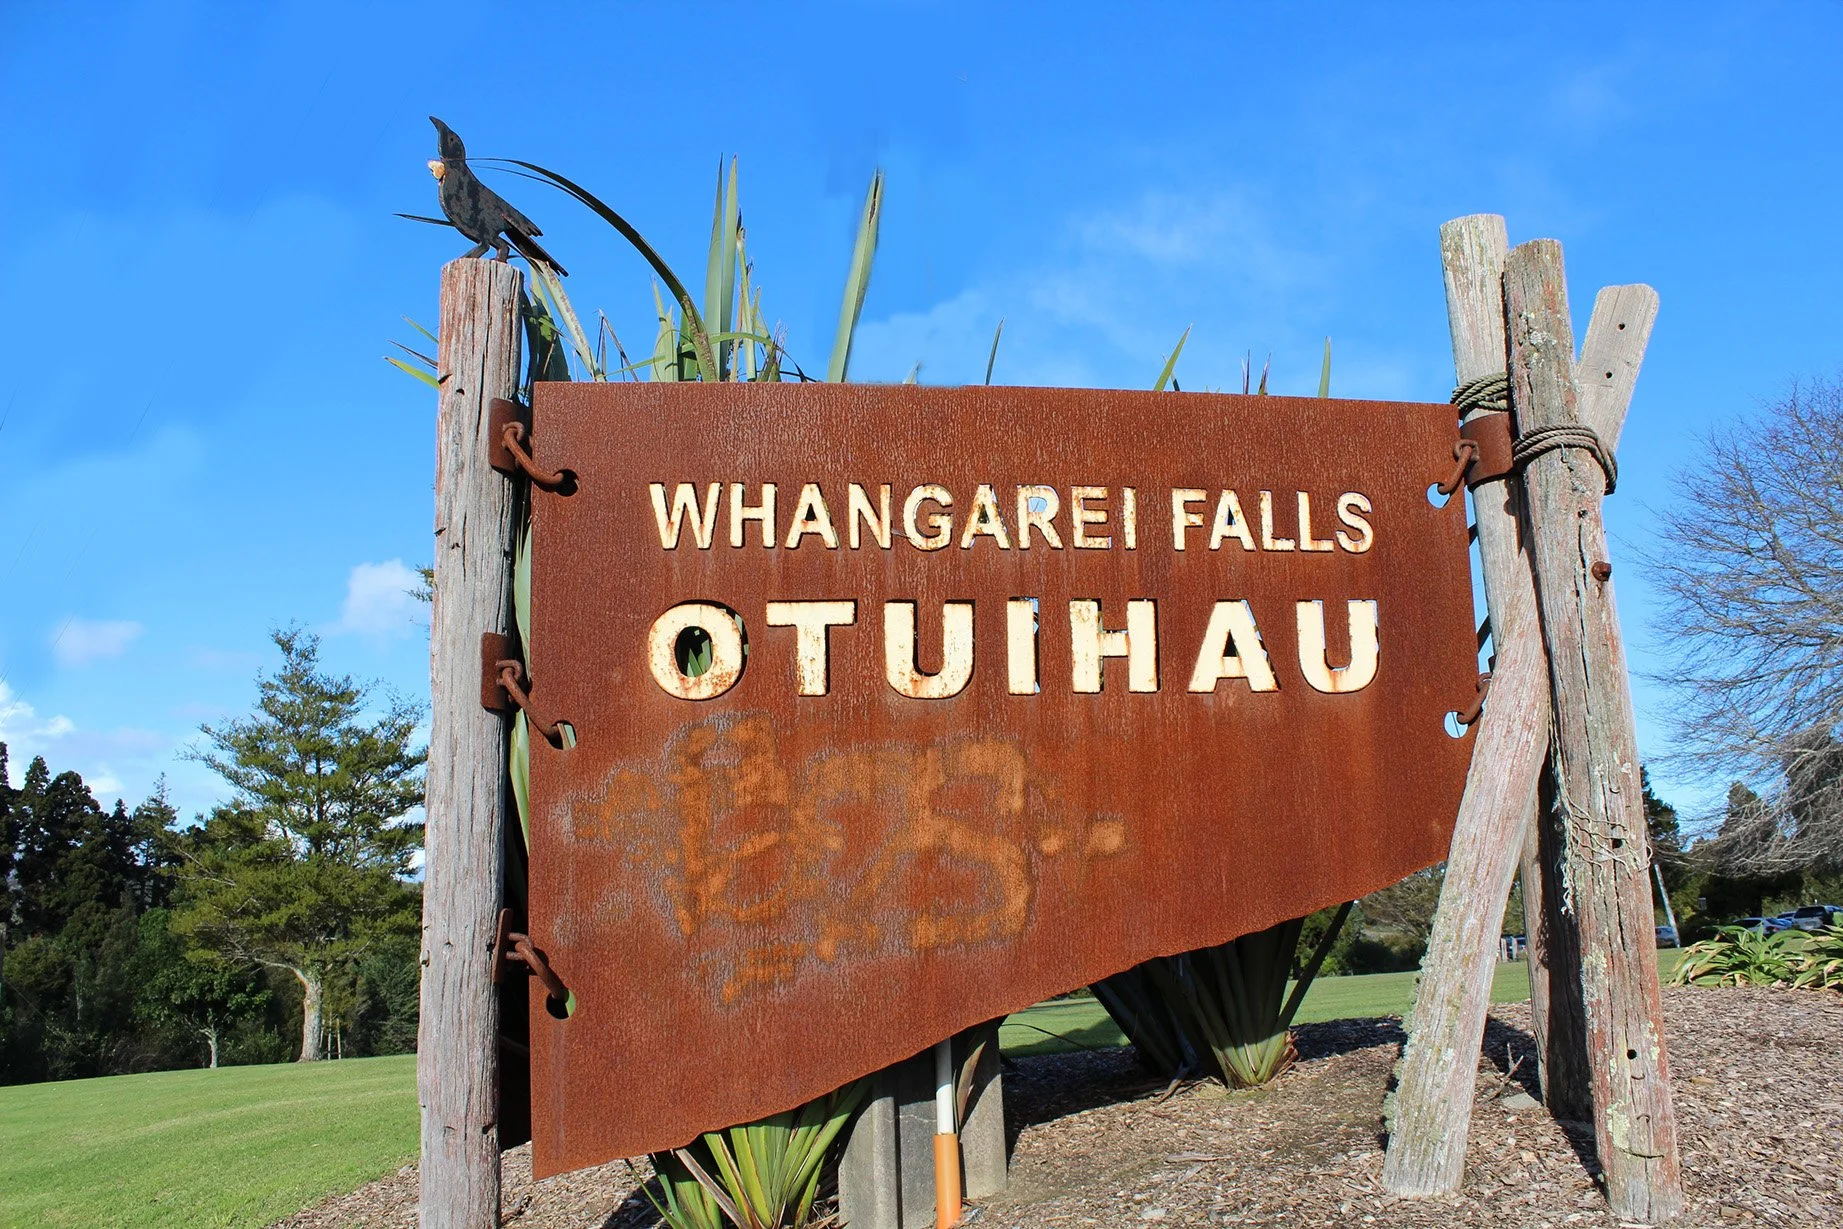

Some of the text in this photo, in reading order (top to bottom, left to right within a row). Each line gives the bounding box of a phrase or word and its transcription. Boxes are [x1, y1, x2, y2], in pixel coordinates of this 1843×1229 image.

[649, 482, 1375, 554] WHANGAREI FALLS
[647, 598, 1380, 700] OTUIHAU
